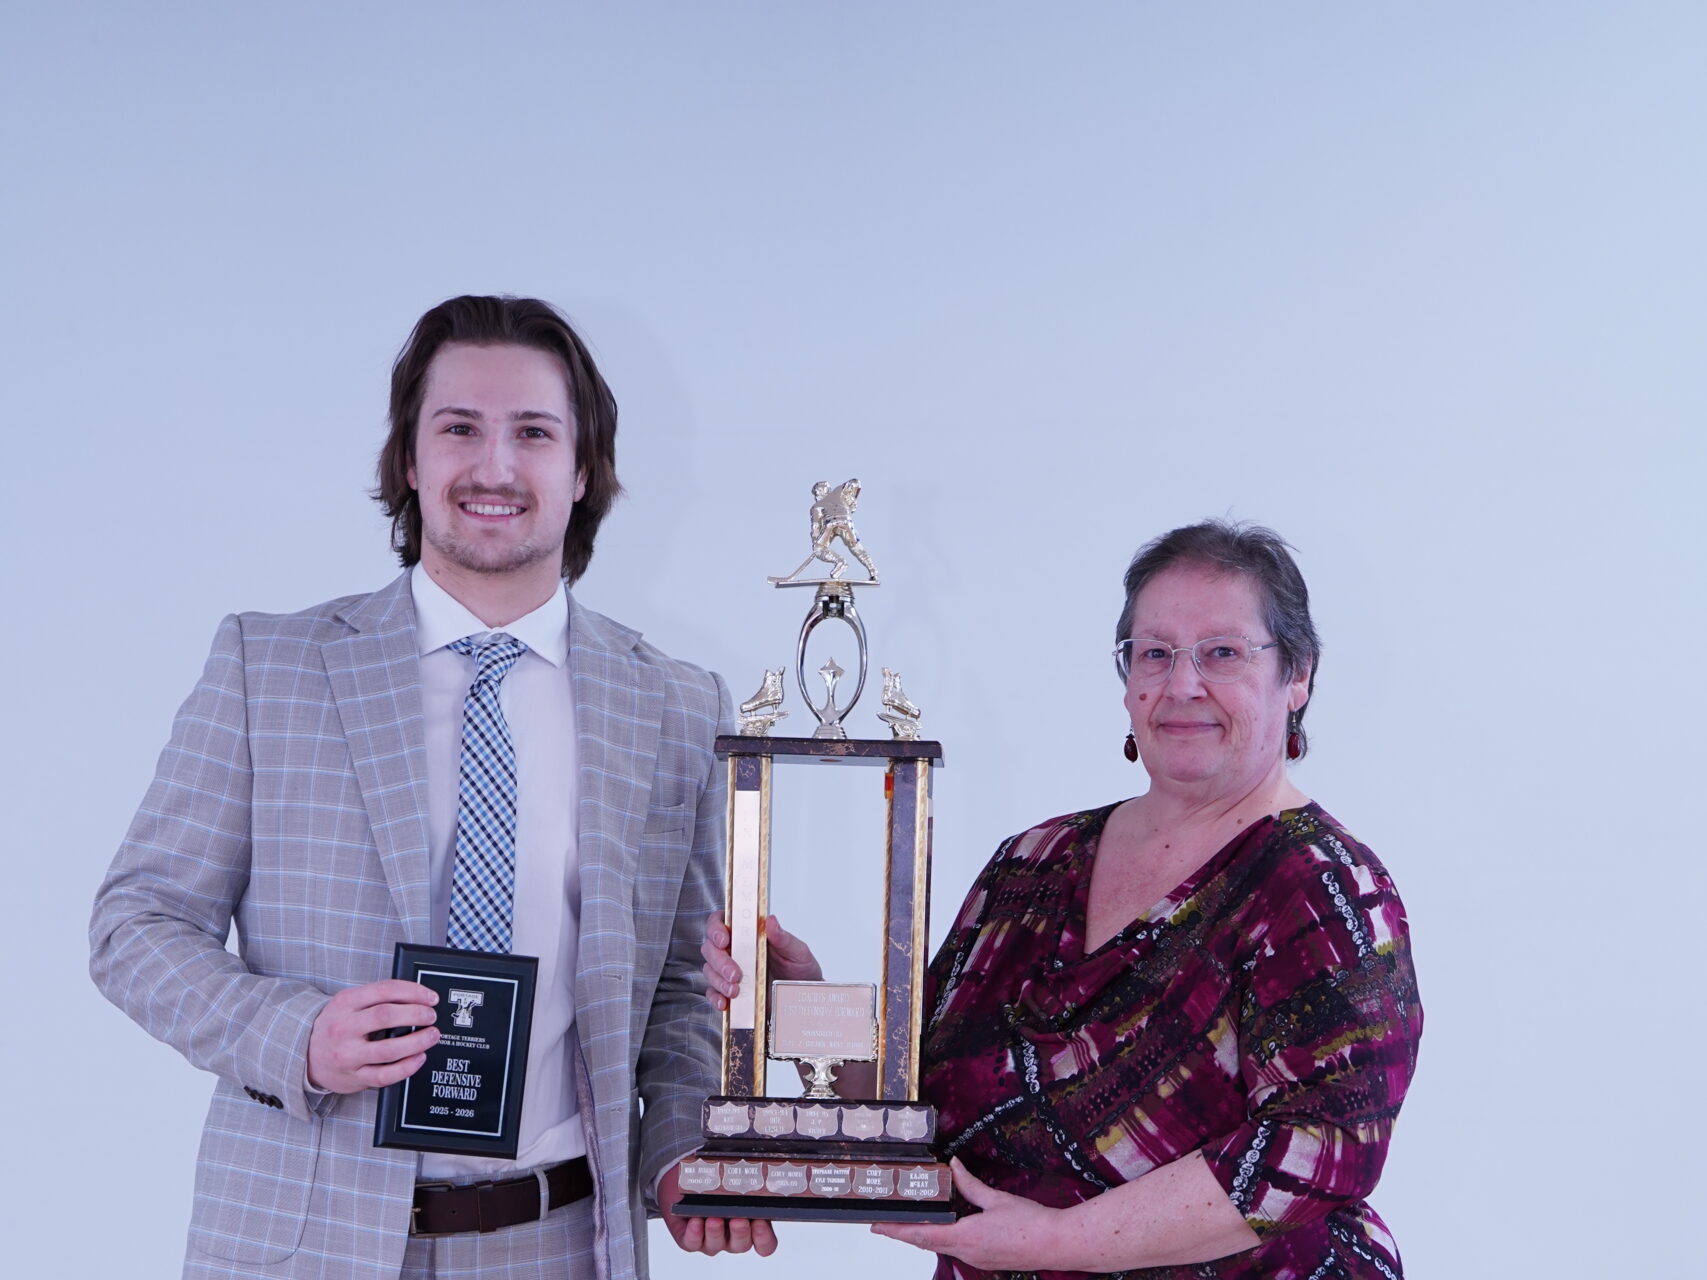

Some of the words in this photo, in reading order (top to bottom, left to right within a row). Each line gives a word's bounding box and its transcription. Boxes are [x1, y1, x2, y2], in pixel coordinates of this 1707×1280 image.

[446, 1058, 471, 1073] BEST
[431, 1071, 482, 1088] DEFENSIVE
[432, 1085, 478, 1101] FORWARD
[429, 1105, 449, 1115] 2025
[455, 1108, 475, 1118] 2026
[866, 1168, 882, 1177] CORY
[903, 1187, 935, 1197] 2011-2012
